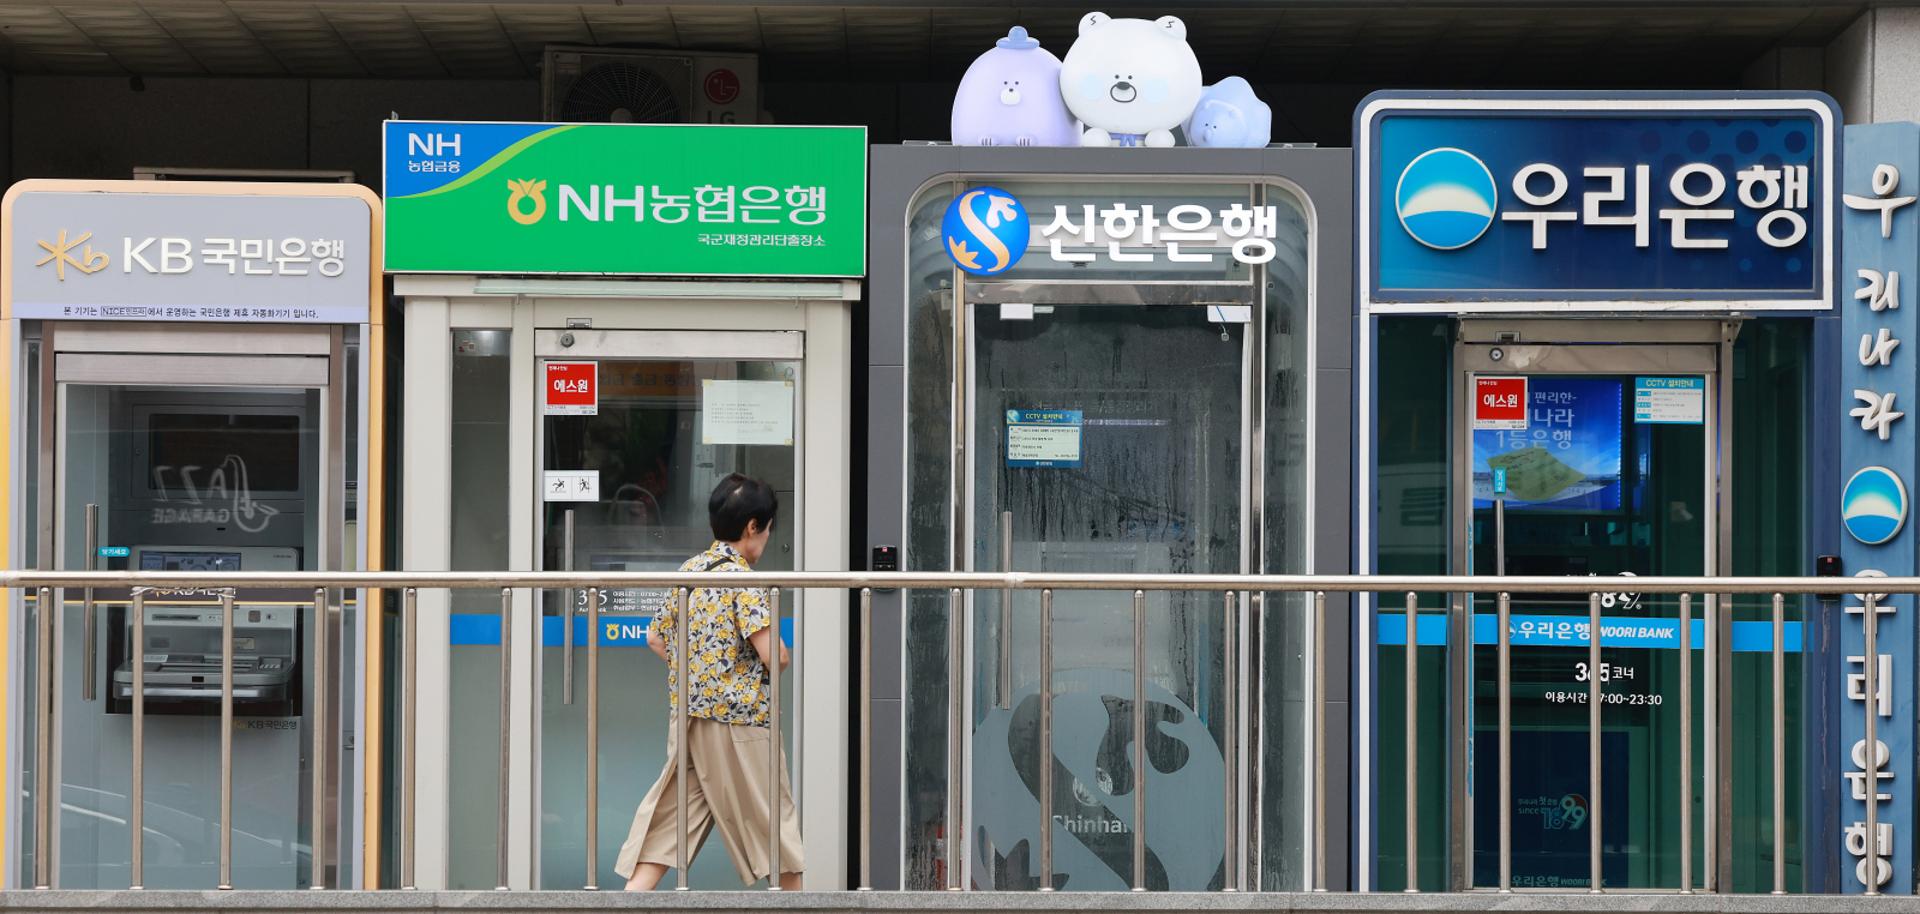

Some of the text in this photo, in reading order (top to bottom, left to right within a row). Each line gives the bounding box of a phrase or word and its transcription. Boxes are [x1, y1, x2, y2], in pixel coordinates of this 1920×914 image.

[408, 132, 462, 157] NH
[408, 159, 461, 174] 농협금융
[558, 183, 827, 226] NH농협은행
[1501, 162, 1809, 250] 우리은행
[697, 232, 826, 248] 국군재정관리단출장소
[1041, 203, 1278, 265] 신한은행
[1842, 163, 1917, 440] 우리나라
[74, 306, 97, 316] 기기는
[166, 307, 197, 318] 운영하는
[199, 307, 230, 318] 국민은행
[233, 308, 249, 317] 제휴
[251, 308, 290, 318] 자동화기기
[293, 309, 319, 319] 입니다.
[553, 379, 588, 393] 에스원
[1645, 379, 1665, 387] CCTV
[1483, 394, 1518, 408] 에스원
[1527, 408, 1575, 428] 나라
[1495, 429, 1572, 450] 1등은행
[578, 589, 608, 606] 35
[1518, 621, 1591, 641] 우리은행
[1638, 627, 1674, 639] BANK
[1575, 662, 1635, 682] 35 코너
[1545, 691, 1663, 705] 이용시간 7:00~23:30
[1511, 875, 1560, 887] 우리은행
